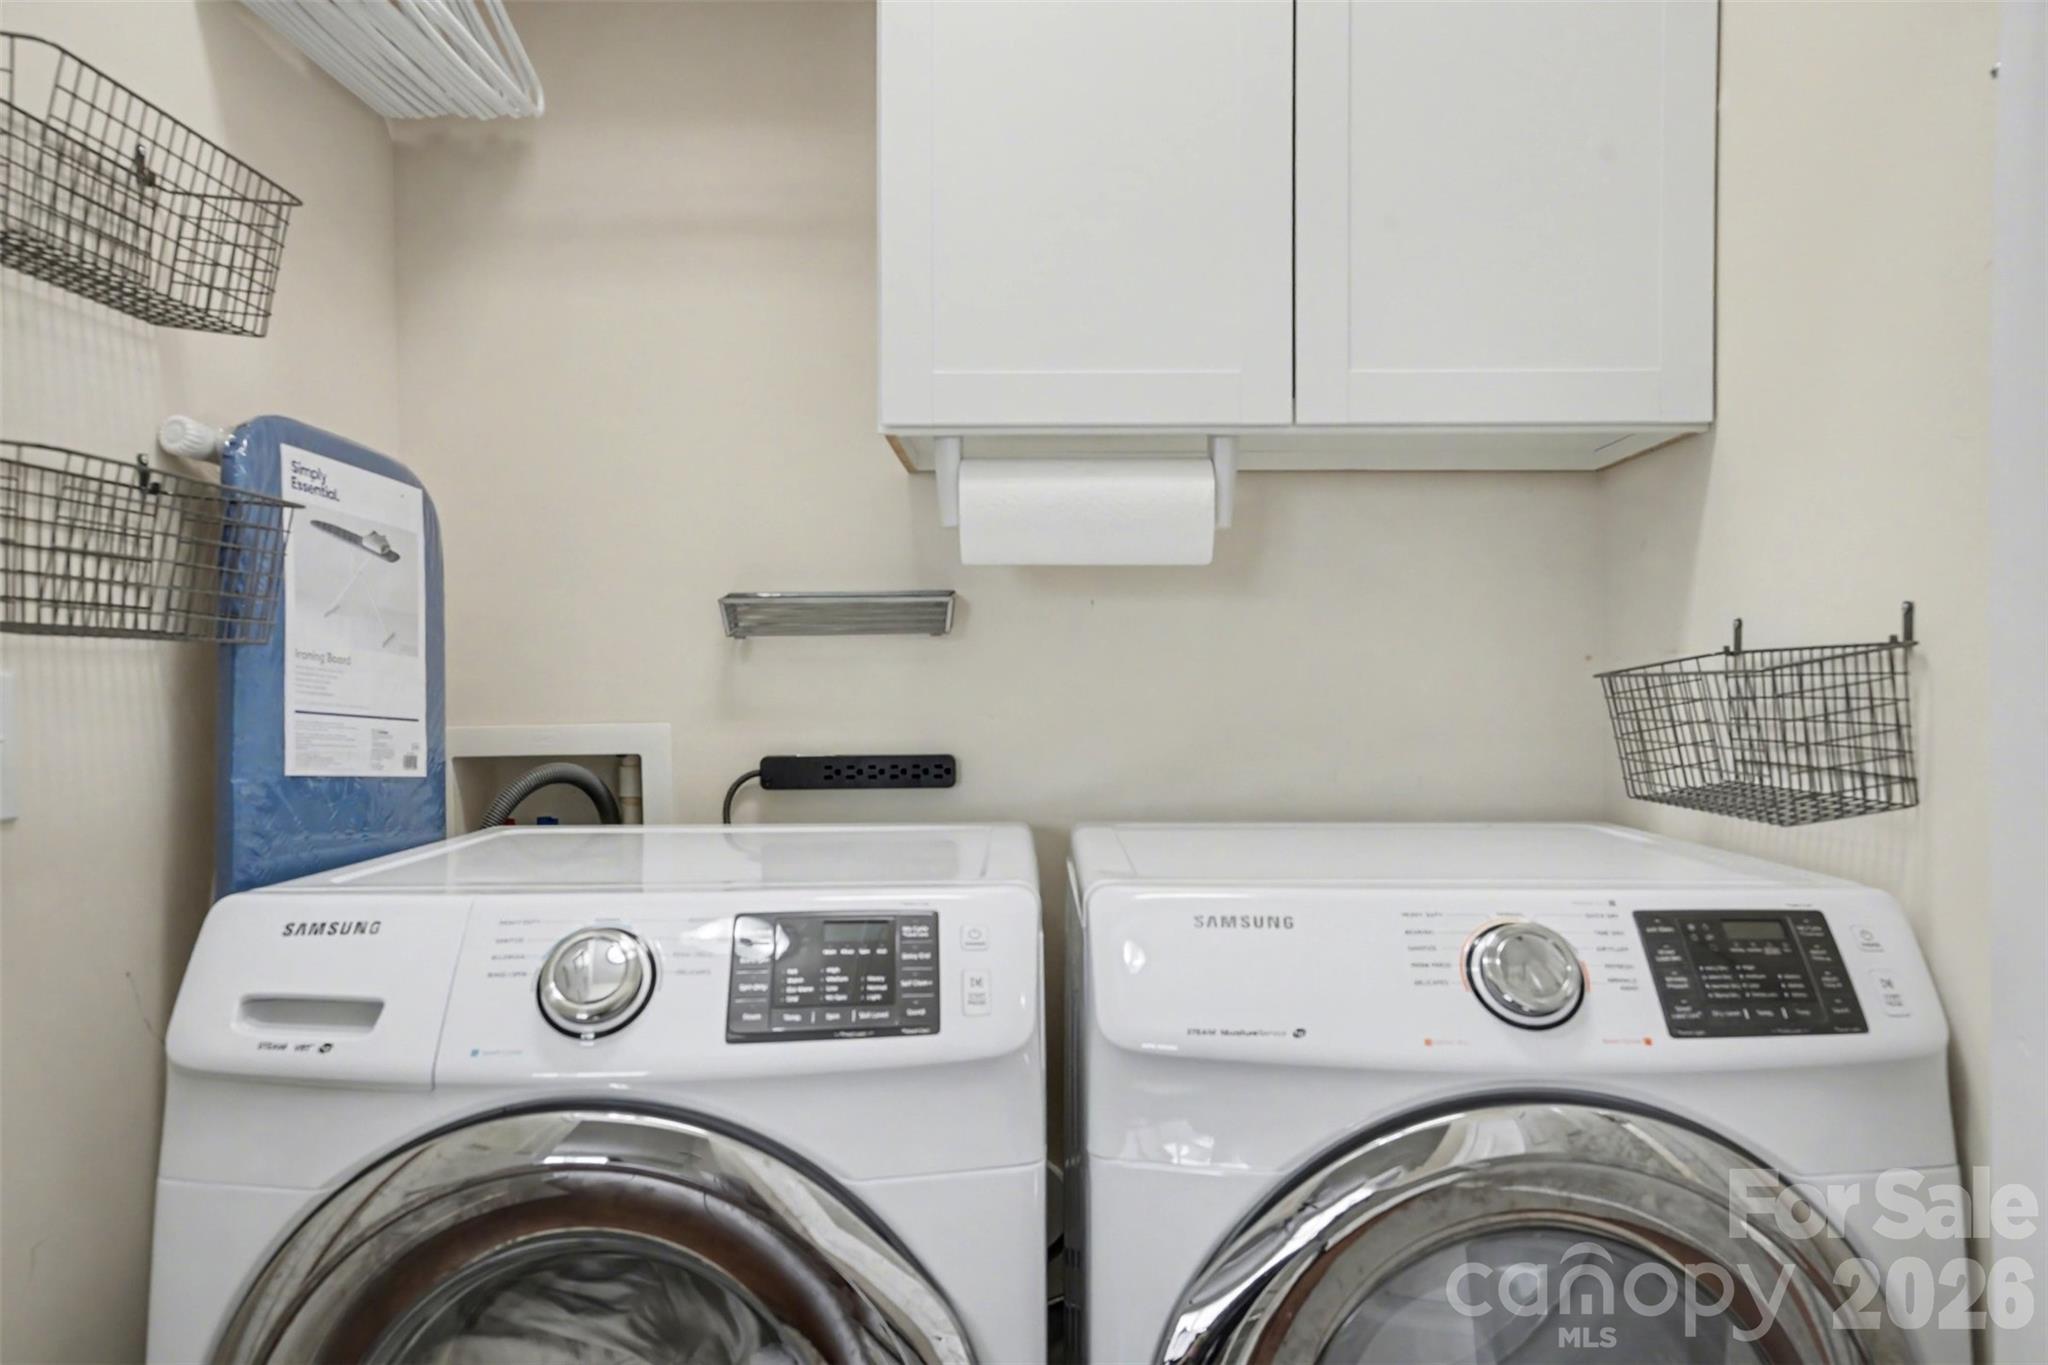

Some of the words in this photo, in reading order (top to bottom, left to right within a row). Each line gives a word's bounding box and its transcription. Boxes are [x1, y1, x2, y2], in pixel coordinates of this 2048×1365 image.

[291, 460, 327, 486] Simply
[294, 649, 325, 665] Ironing
[327, 652, 352, 666] Board
[282, 920, 382, 937] SAMSUNG
[1193, 915, 1295, 929] SAMSUNG
